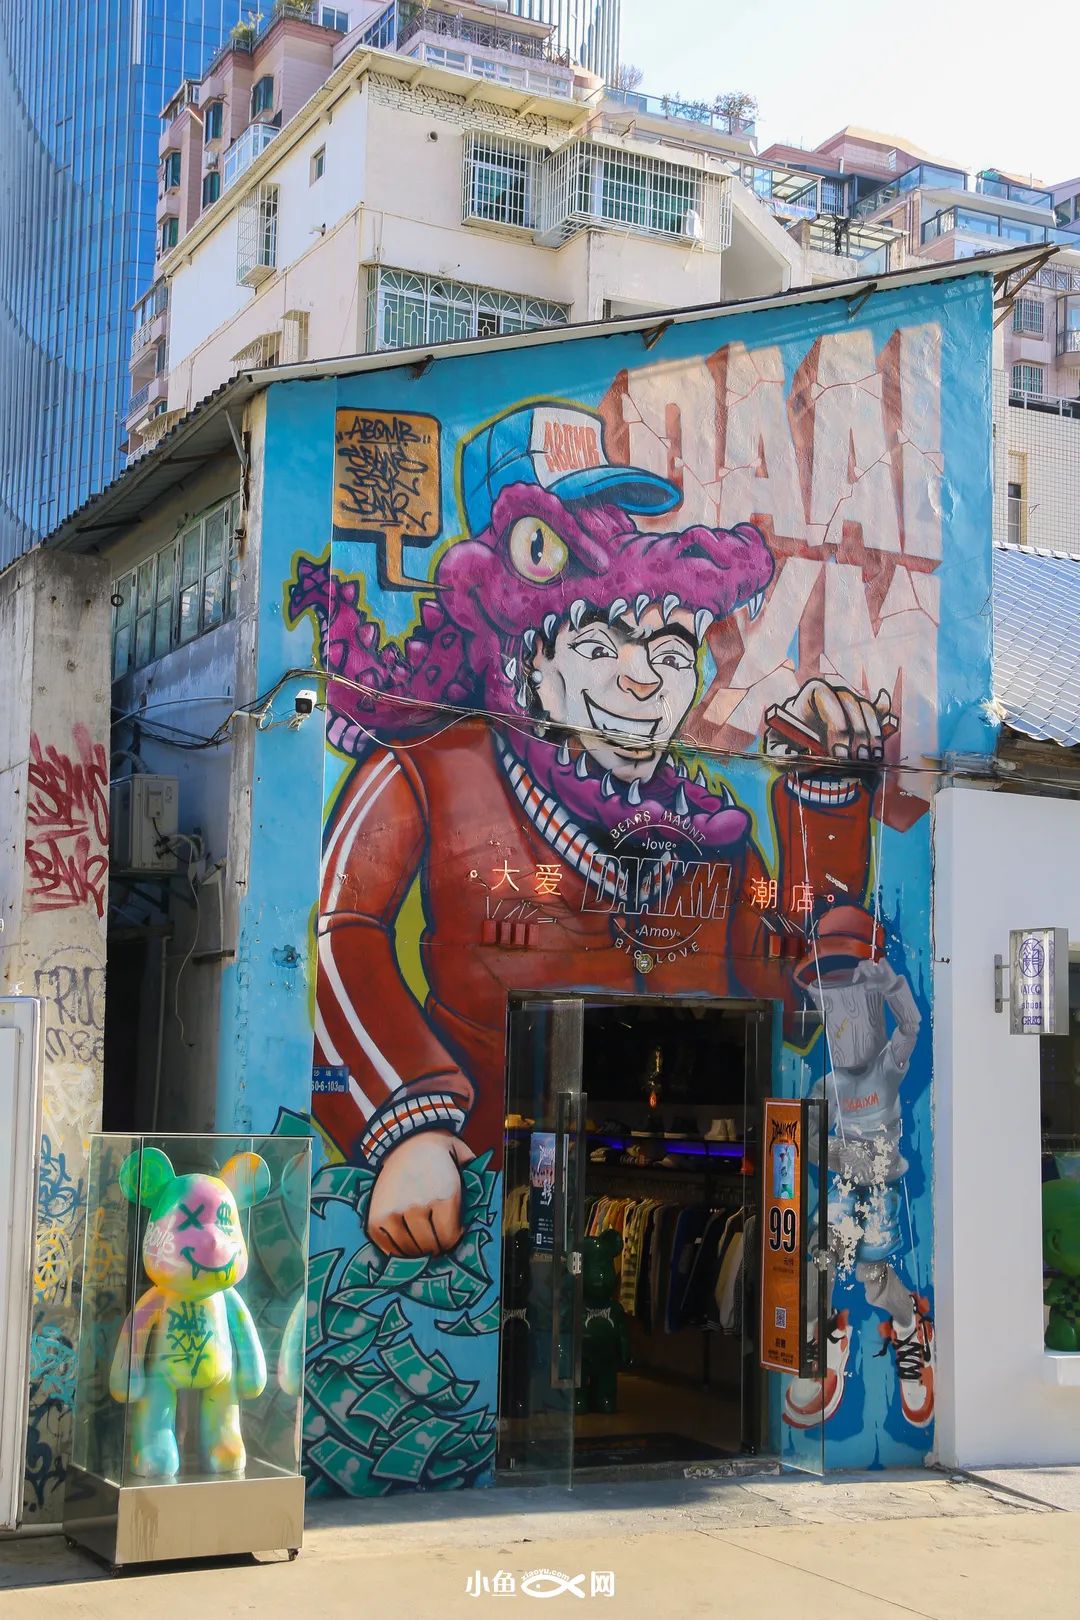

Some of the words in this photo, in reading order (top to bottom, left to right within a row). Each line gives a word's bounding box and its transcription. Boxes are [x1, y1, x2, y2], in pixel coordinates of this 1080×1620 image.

[609, 810, 652, 840] BEARS
[661, 810, 707, 843] HAUNT
[645, 837, 673, 850] love
[490, 859, 564, 896] 大爱
[750, 876, 816, 913] 潮店
[638, 924, 677, 941] Amoy
[614, 937, 642, 960] BIG
[656, 941, 700, 964] LOVE
[768, 1206, 797, 1254] 99
